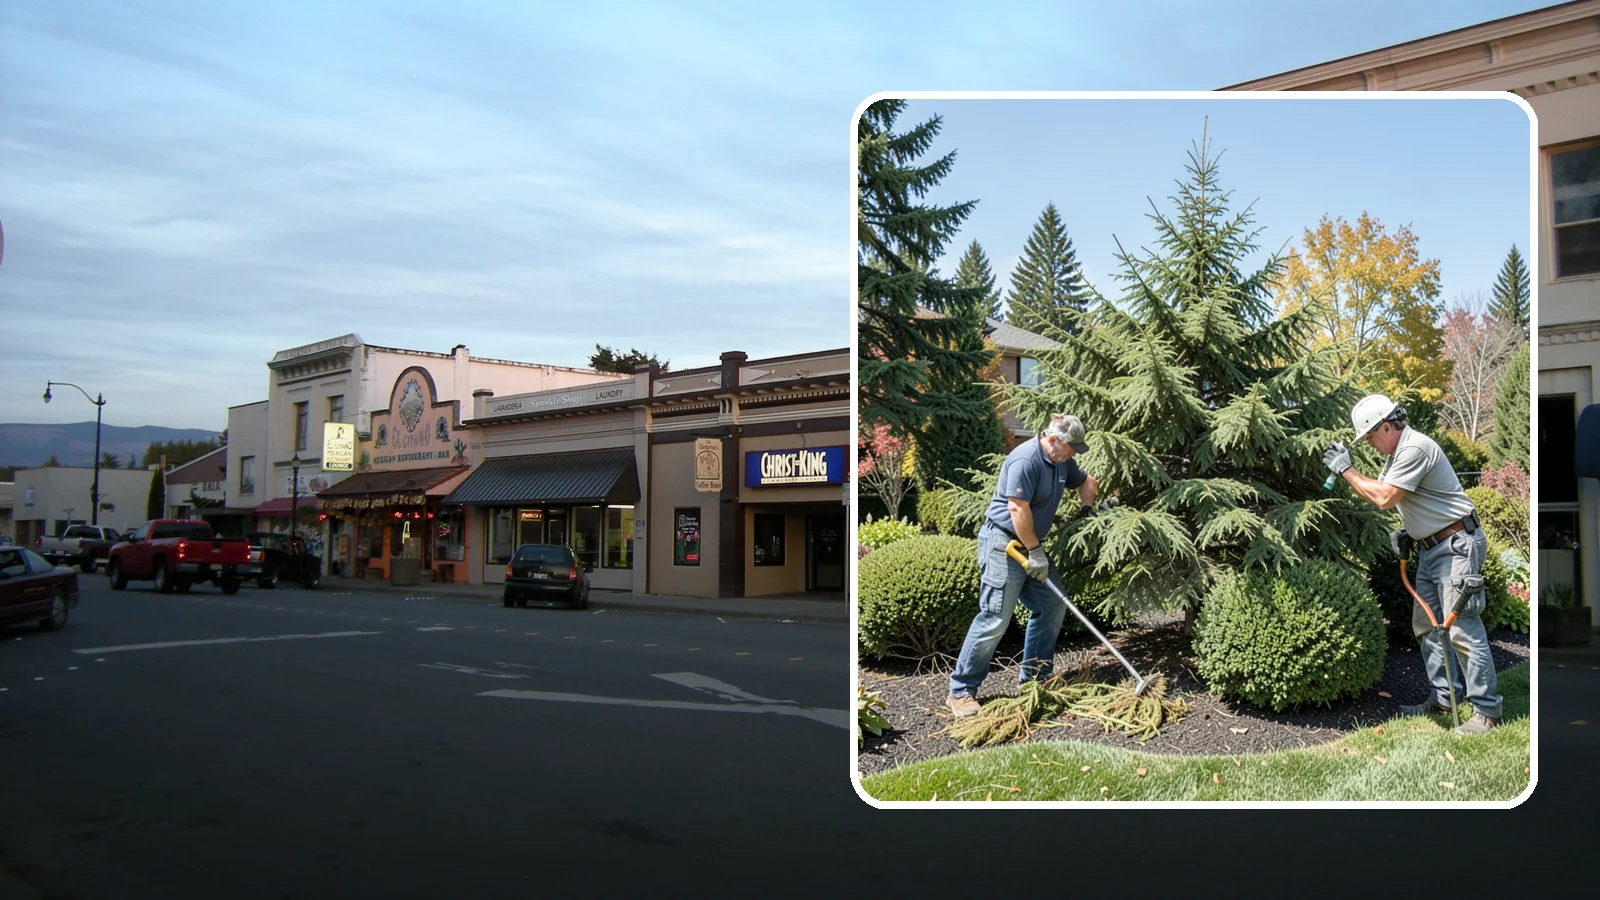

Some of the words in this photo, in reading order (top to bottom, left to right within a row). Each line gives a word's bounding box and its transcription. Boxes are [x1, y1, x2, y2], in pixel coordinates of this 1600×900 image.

[595, 388, 624, 400] LAUNDRY
[493, 402, 523, 413] LAVANDERIA
[530, 396, 561, 409] Sparkle
[562, 394, 583, 405] Shop
[373, 455, 396, 464] MEXICAN
[397, 451, 433, 462] RESTAURANT
[438, 450, 450, 459] BAR
[761, 452, 798, 478] CHRIST
[799, 450, 827, 476] KING
